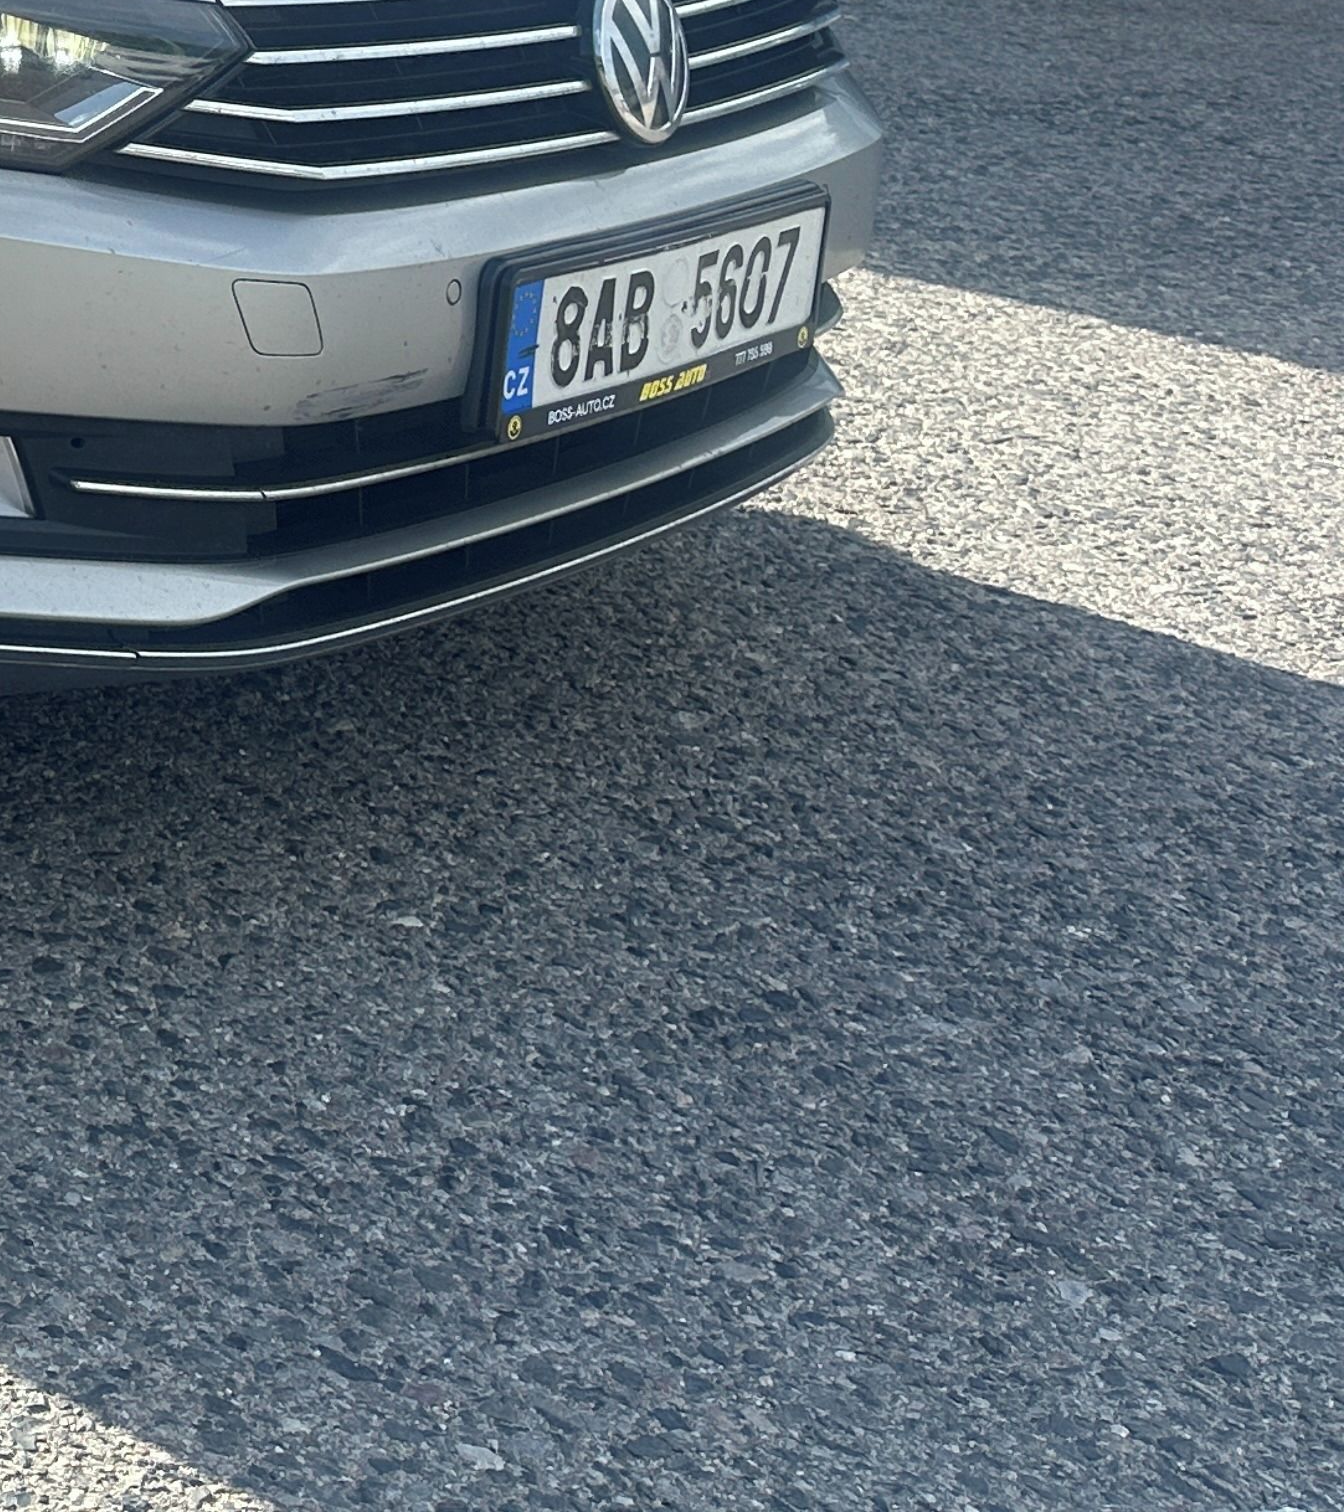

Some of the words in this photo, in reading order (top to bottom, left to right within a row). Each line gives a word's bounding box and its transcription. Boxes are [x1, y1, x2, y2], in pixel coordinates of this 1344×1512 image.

[551, 269, 656, 388] 8AB
[690, 224, 802, 349] 5607
[502, 364, 531, 400] CZ
[639, 374, 674, 402] BOSS
[674, 363, 708, 391] AUTO
[546, 394, 616, 426] BOSS-AUTO.CZ
